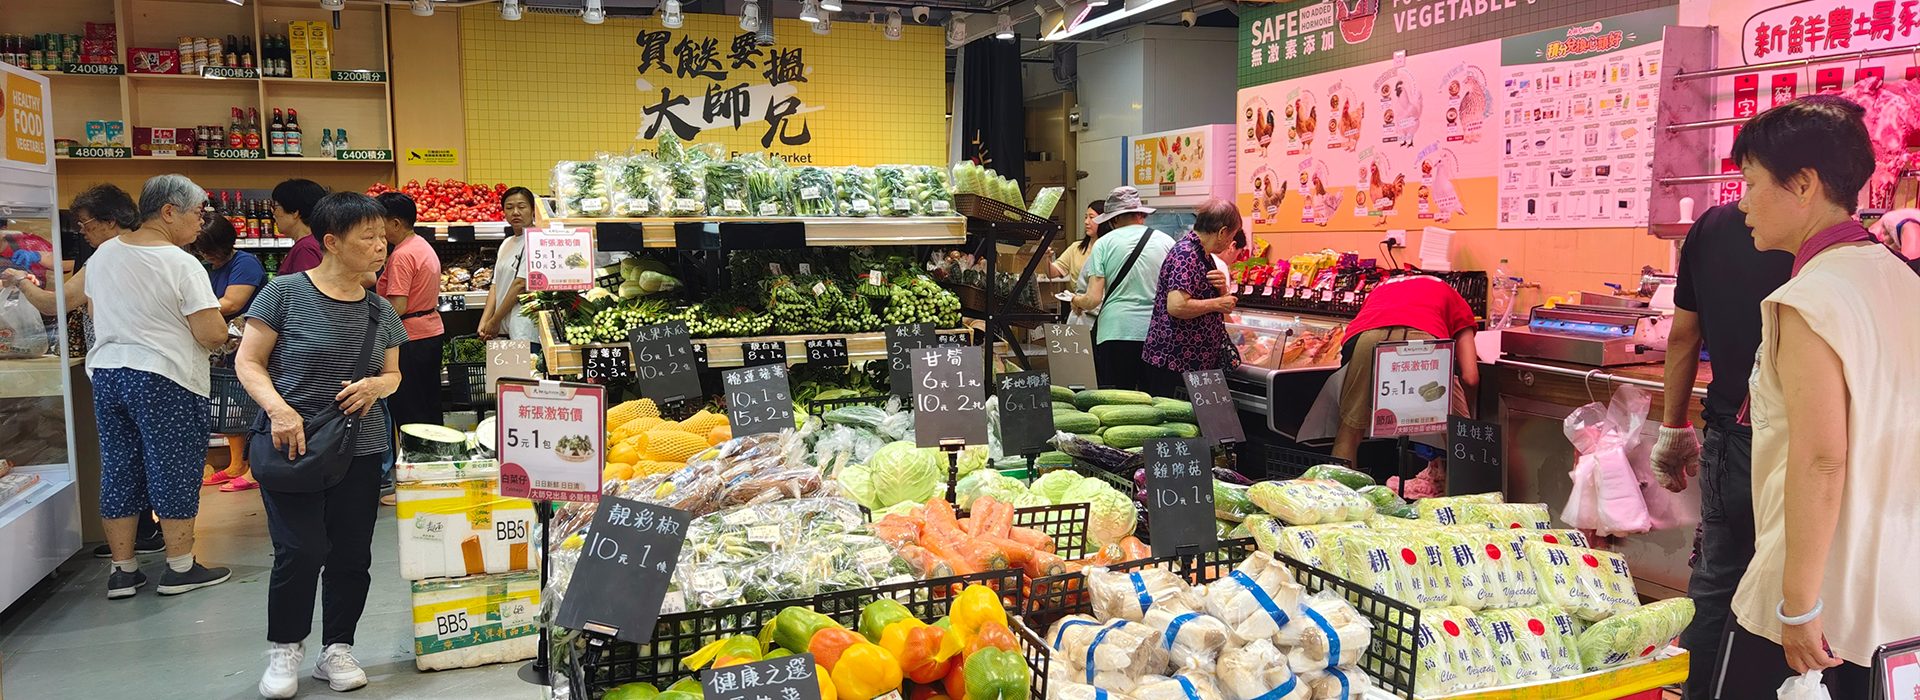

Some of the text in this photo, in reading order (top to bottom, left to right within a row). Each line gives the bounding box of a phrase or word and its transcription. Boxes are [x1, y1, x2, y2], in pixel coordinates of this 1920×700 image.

[1301, 5, 1332, 20] NO ADDED
[1251, 10, 1298, 46] SAFE
[1301, 16, 1332, 30] HORMONE
[636, 29, 808, 87] 買餸要搵
[1251, 31, 1334, 67] 無激素添加
[70, 64, 118, 74] 2400積分
[207, 67, 254, 78] 2800積分
[337, 71, 381, 82] 3200積分
[12, 90, 41, 111] HEALTHY
[14, 109, 42, 136] FOOD
[642, 82, 811, 149] 大師兄
[16, 137, 44, 154] VEGETABLE
[75, 148, 125, 158] 4800積分
[213, 149, 260, 159] 5600積分
[342, 150, 386, 160] 6400積分
[636, 324, 687, 342] 水果木瓜
[1381, 380, 1415, 397] 5元1盒
[518, 405, 583, 422] 新張激筍價
[507, 428, 552, 450] 5元1包
[1456, 421, 1496, 443] 娃娃菜
[1156, 441, 1191, 458] 粒粒
[501, 474, 528, 485] 白菜仔
[535, 480, 560, 488] 日日新鮮
[531, 490, 567, 501] 大師兄出品
[607, 503, 680, 537] 靚彩椒
[496, 519, 525, 541] BB5
[1368, 545, 1442, 573] 耕 野
[1452, 543, 1476, 568] 耕
[1549, 549, 1629, 578] 耕 野
[436, 611, 468, 636] BB5
[1491, 615, 1574, 645] 耕 野
[708, 657, 813, 694] 健康之選
